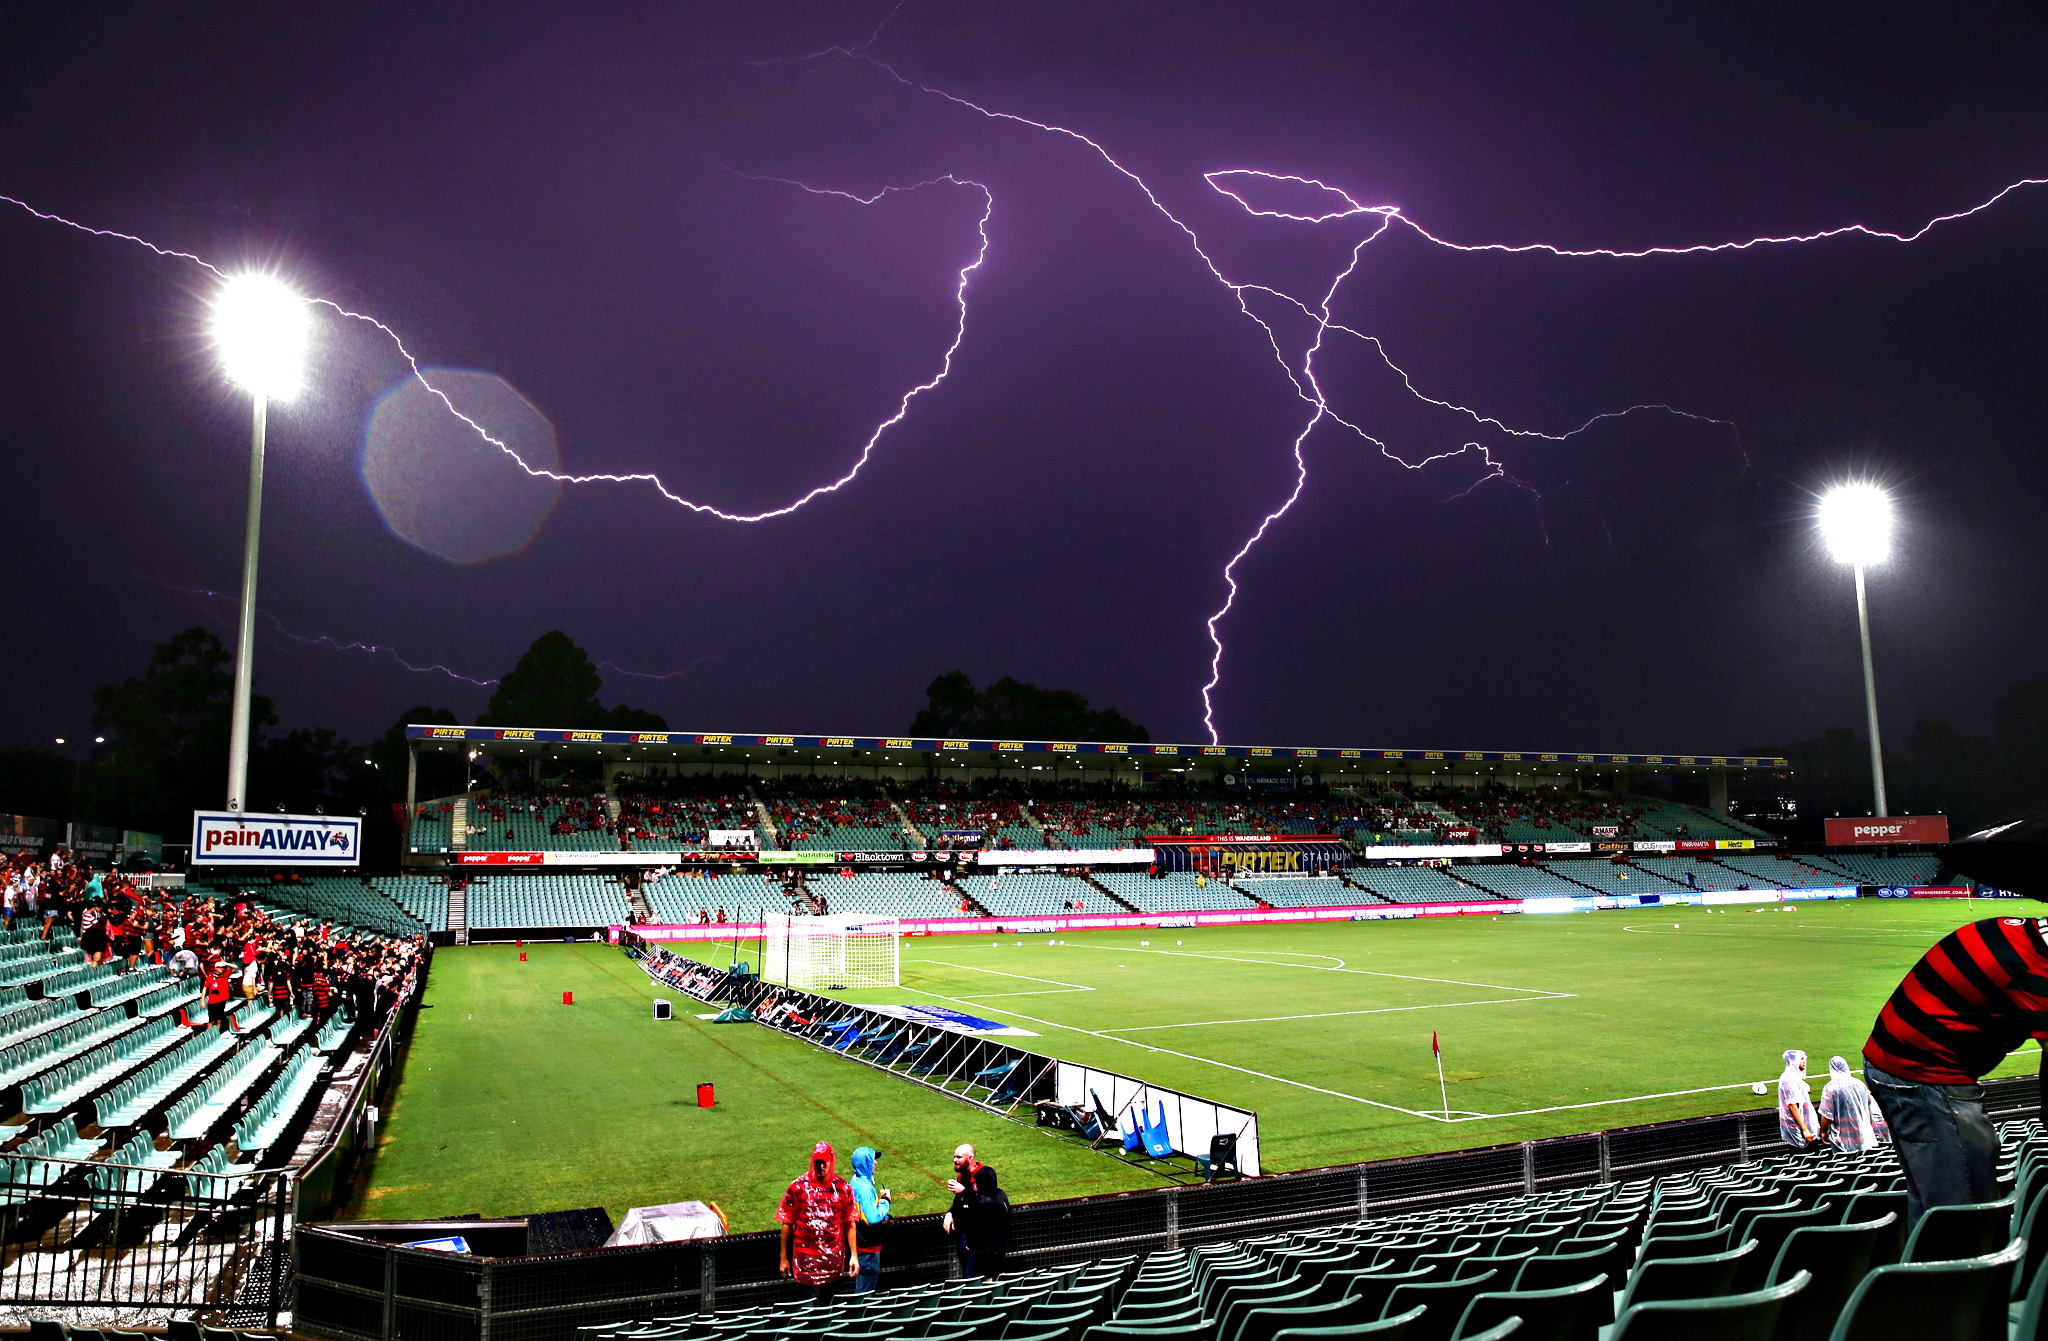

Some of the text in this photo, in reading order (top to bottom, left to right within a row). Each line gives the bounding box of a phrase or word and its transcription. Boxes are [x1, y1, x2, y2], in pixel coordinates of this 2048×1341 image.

[206, 825, 332, 851] painAWAY
[1854, 825, 1902, 837] pepper
[855, 853, 904, 861] Blacktown
[1220, 851, 1350, 870] PIRTEK STADIUM
